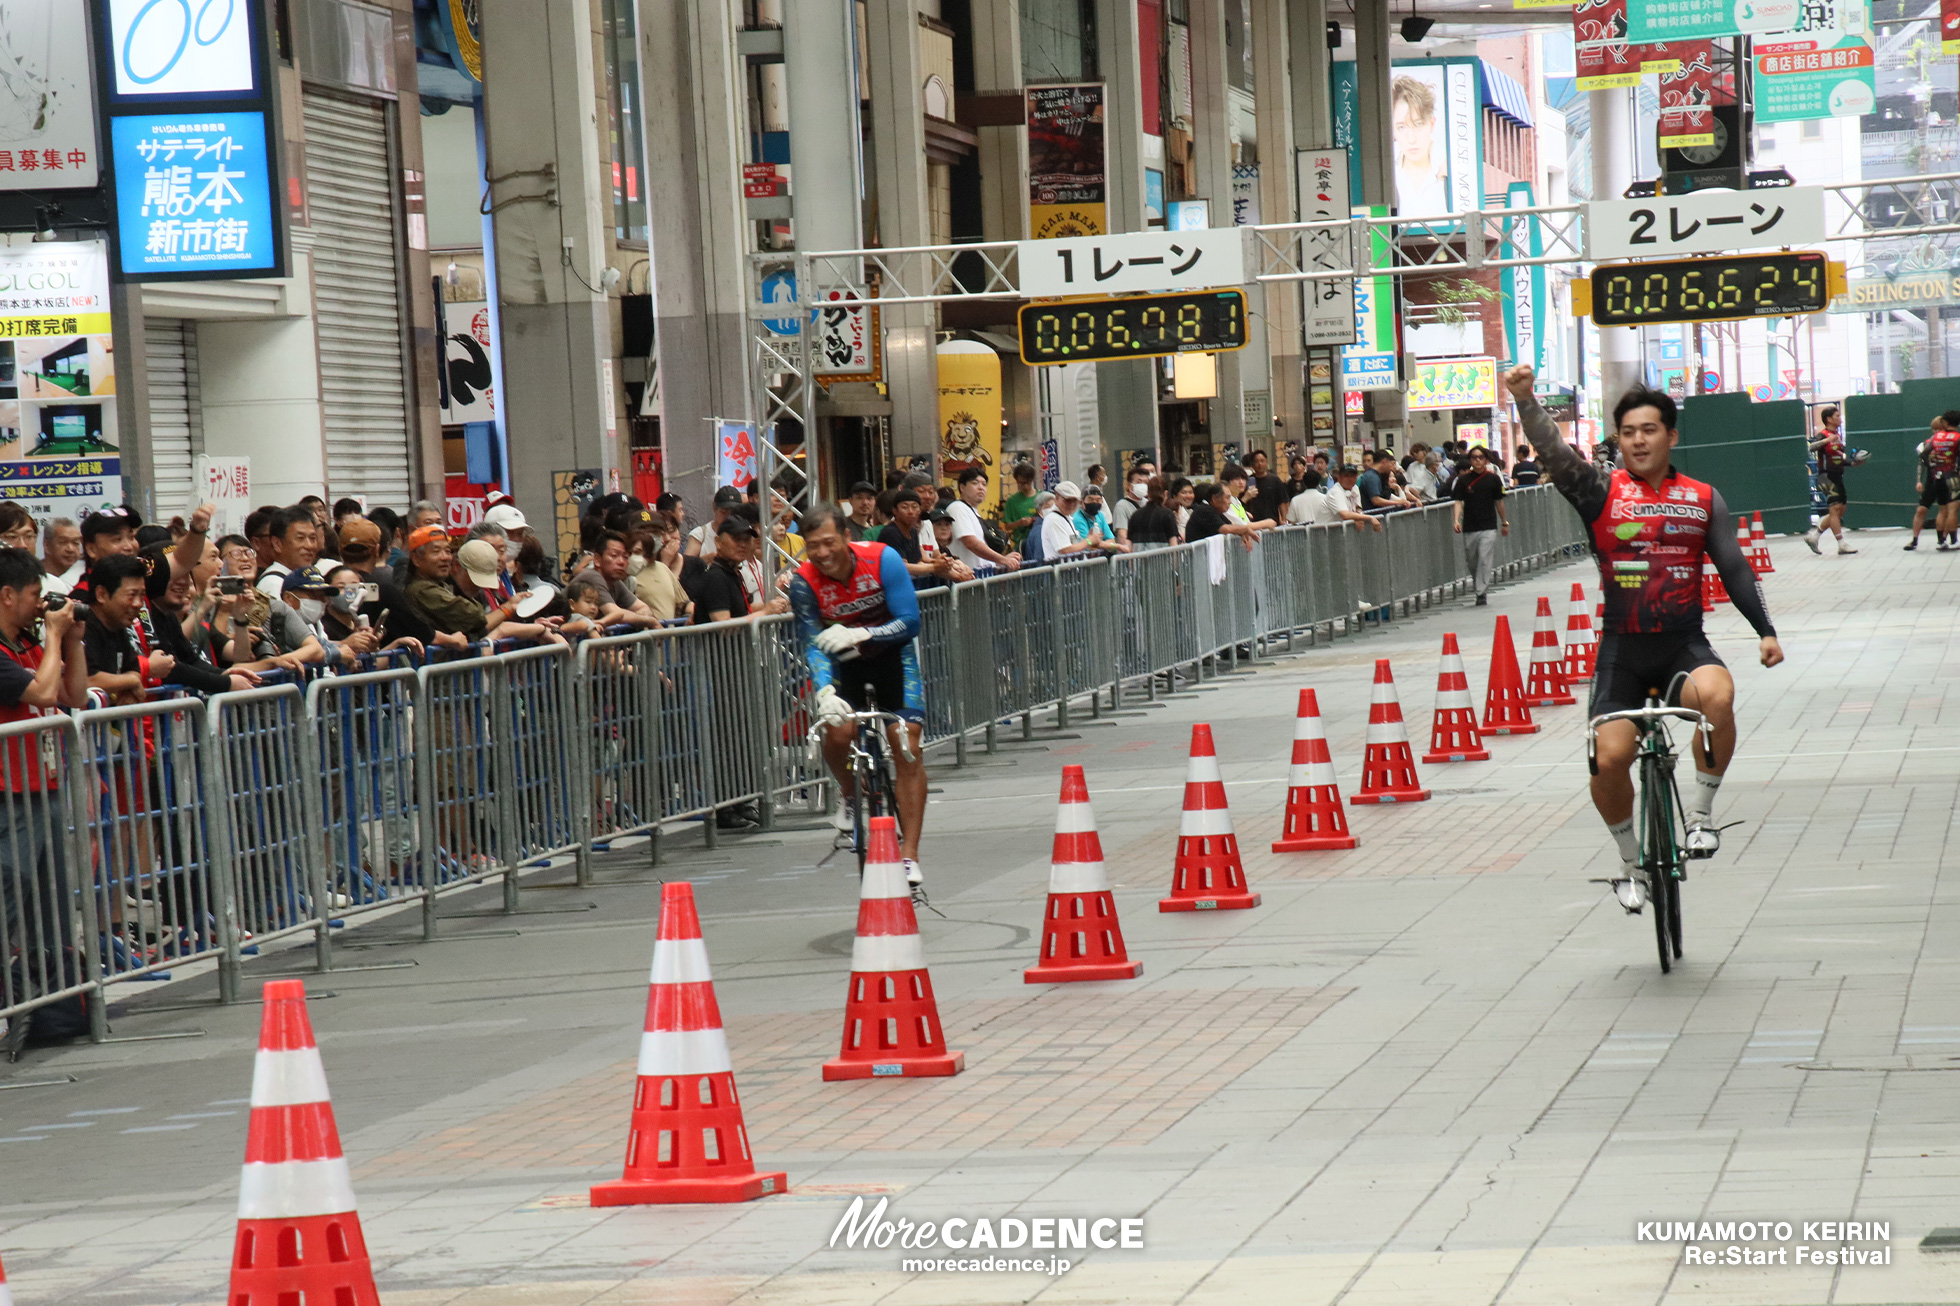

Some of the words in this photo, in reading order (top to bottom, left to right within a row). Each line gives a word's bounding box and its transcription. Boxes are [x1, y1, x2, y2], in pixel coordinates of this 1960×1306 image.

[136, 135, 244, 163] サテライト
[0, 147, 87, 172] 員募集中
[145, 216, 249, 255] 新市街
[144, 254, 177, 263] SATELLITE
[1755, 307, 1781, 315] SEIKO
[1178, 343, 1203, 351] SEIKO
